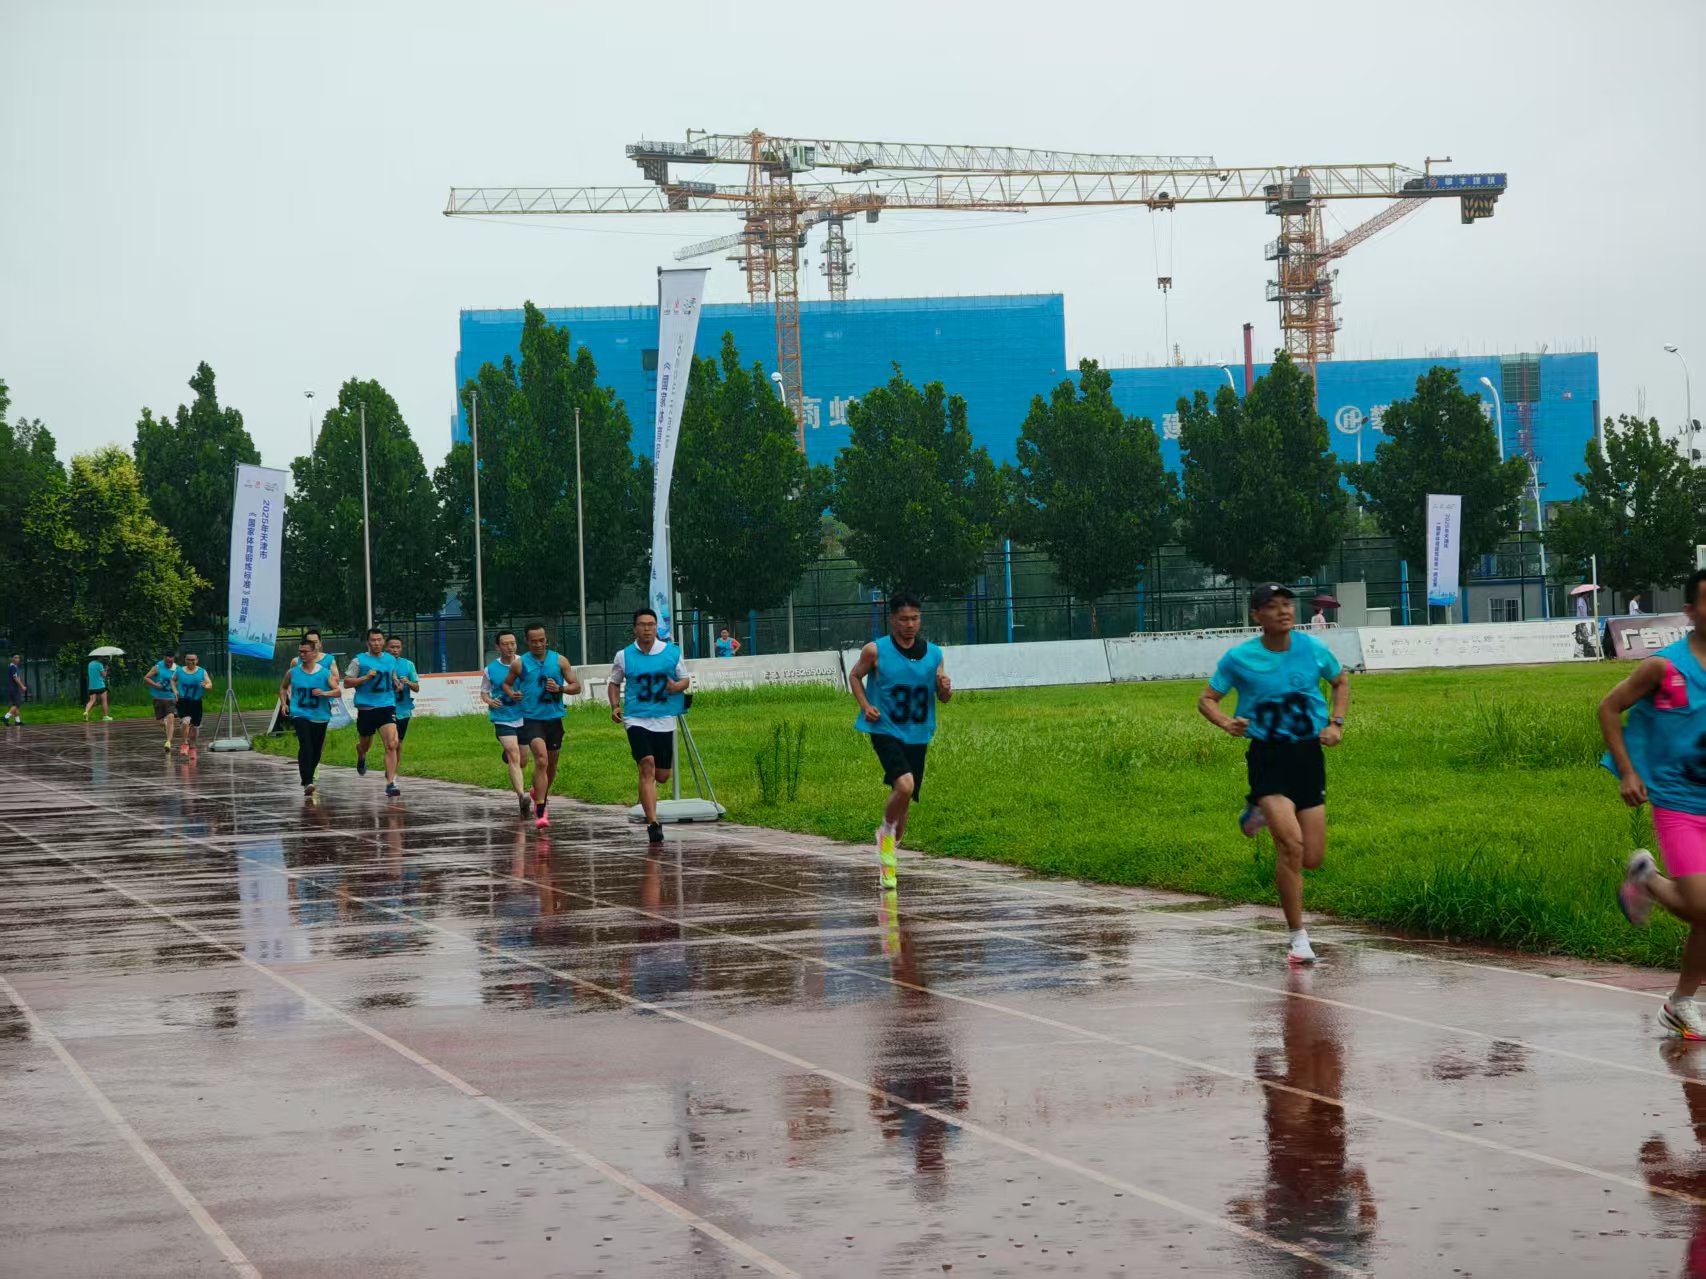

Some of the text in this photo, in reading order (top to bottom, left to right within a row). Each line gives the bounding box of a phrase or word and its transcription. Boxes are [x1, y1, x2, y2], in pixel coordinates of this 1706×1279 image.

[259, 499, 270, 560] 2025年天津市
[297, 687, 319, 708] 25
[371, 671, 391, 693] 21
[636, 672, 668, 703] 32
[890, 683, 929, 724] 33
